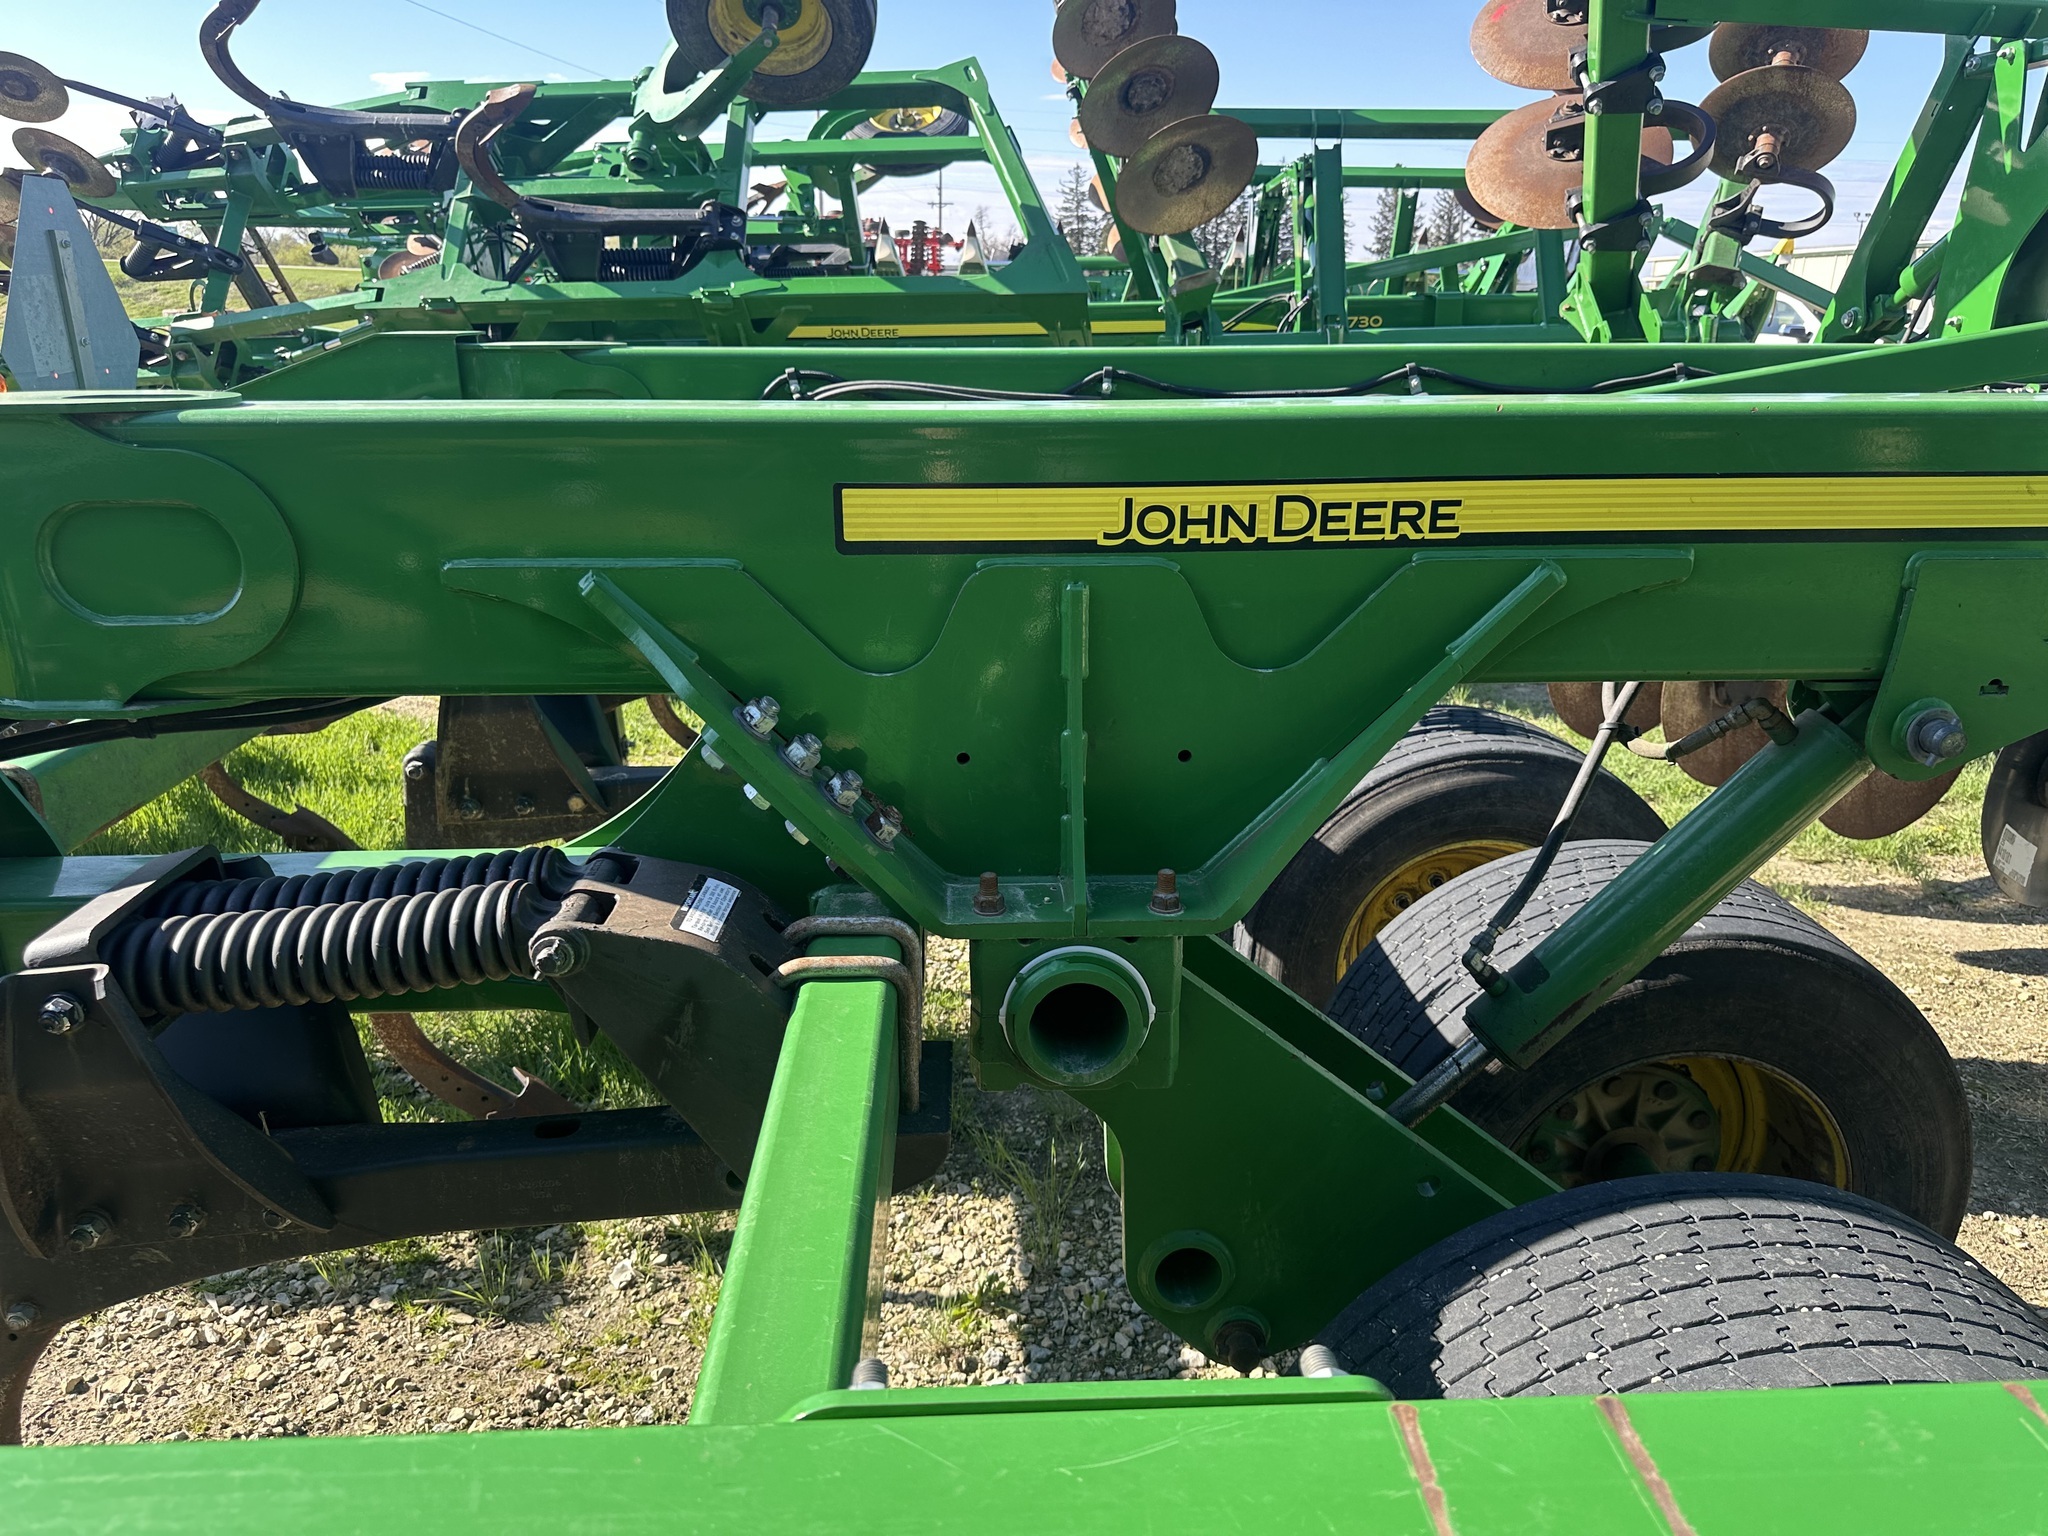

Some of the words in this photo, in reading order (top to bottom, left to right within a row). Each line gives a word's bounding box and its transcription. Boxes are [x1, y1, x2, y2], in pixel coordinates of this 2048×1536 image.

[827, 327, 859, 338] JOHN
[861, 327, 899, 338] DEERE
[1102, 497, 1258, 541] JOHN
[1273, 494, 1463, 538] DEERE
